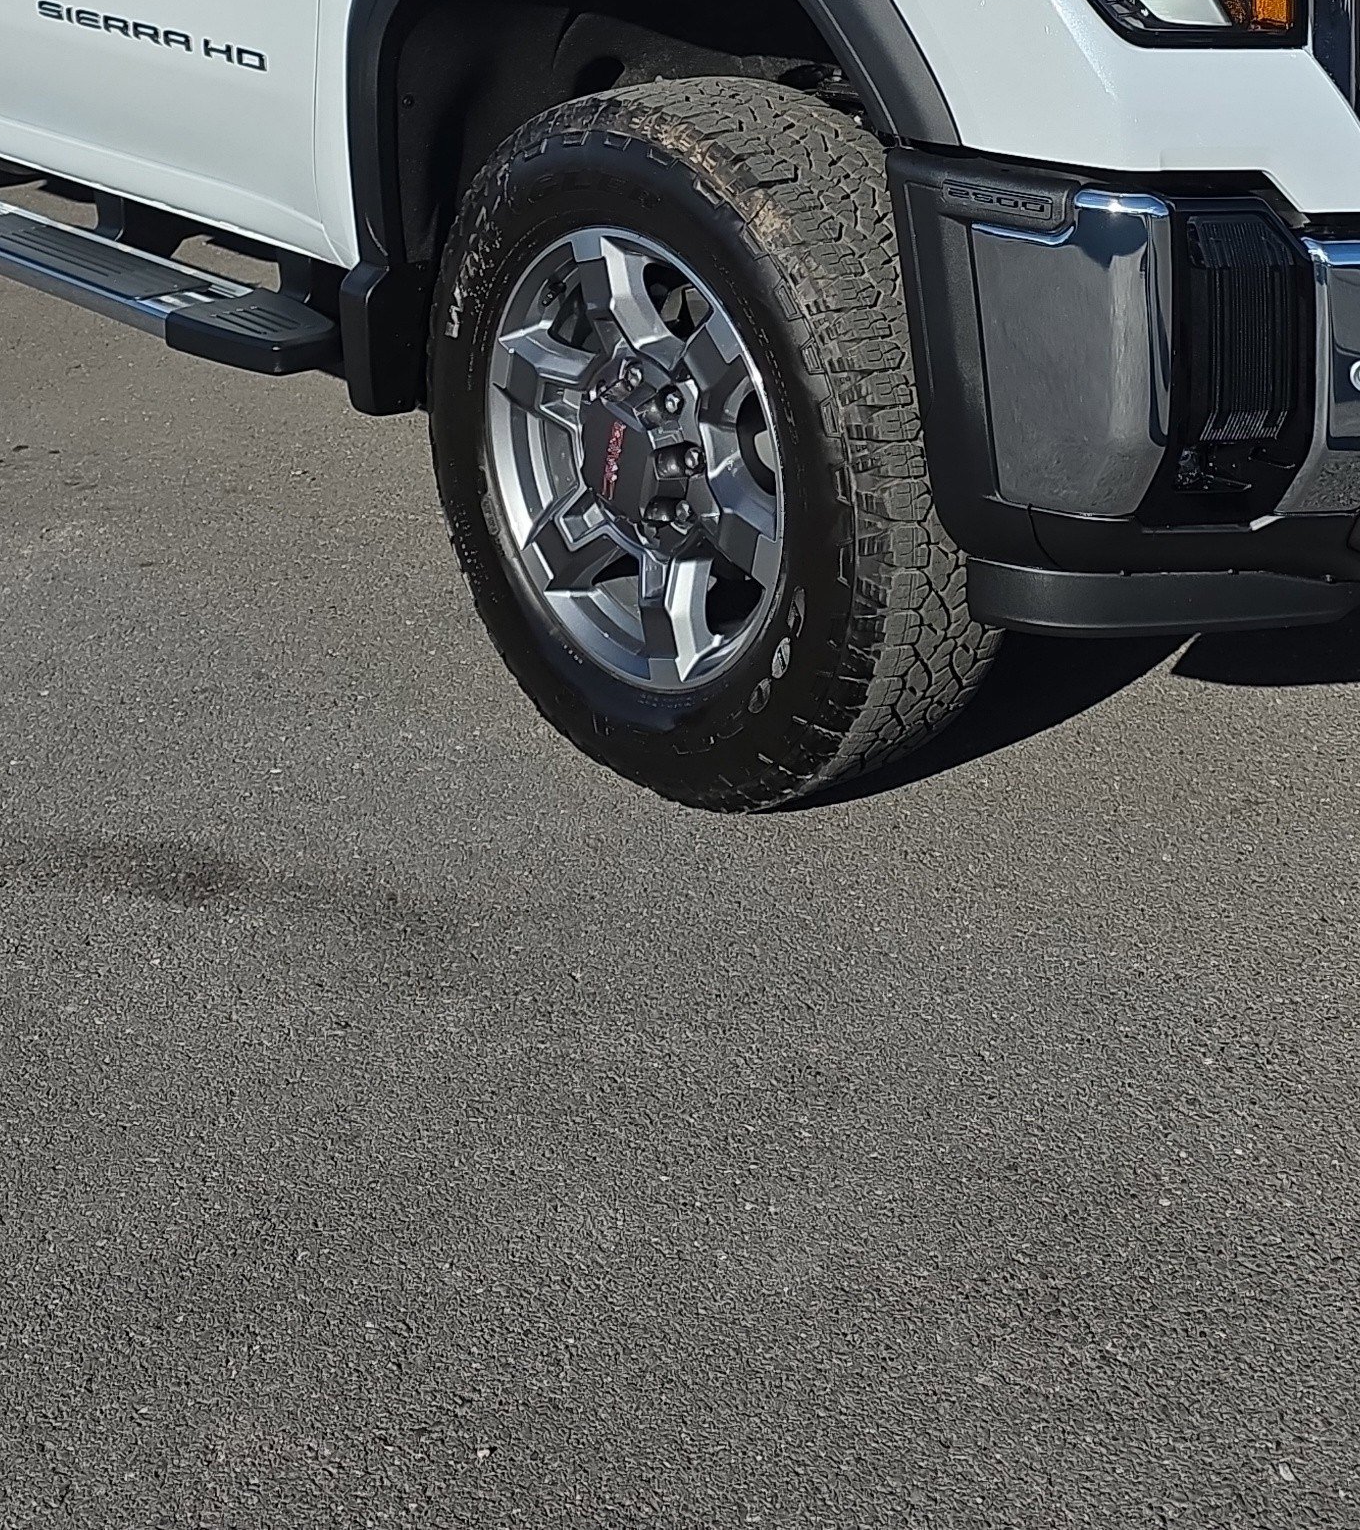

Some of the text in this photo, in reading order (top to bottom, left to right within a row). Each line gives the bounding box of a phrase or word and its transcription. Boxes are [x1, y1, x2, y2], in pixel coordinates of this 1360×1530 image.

[37, 0, 268, 72] SIERRA HD
[947, 188, 1045, 213] 2500
